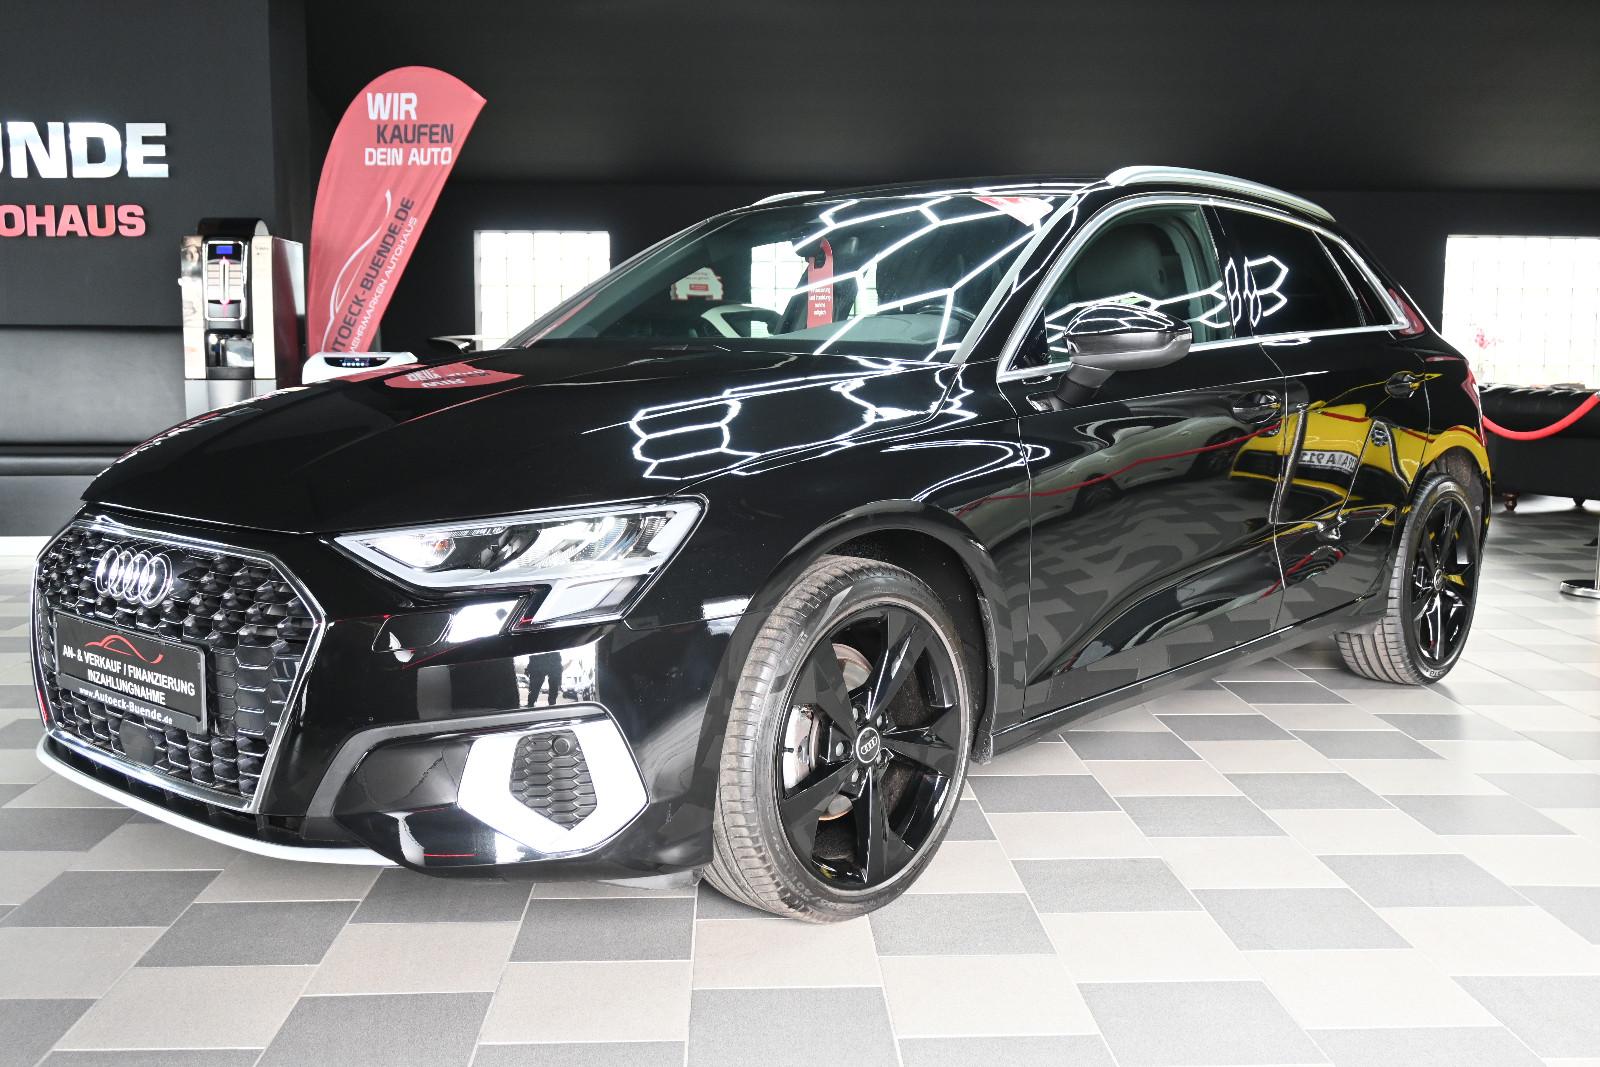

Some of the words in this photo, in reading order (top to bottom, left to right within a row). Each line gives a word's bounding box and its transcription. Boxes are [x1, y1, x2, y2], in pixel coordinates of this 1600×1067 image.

[366, 92, 418, 120] WIR
[0, 121, 169, 178] NDE
[376, 123, 454, 144] KAUFEN
[364, 147, 403, 166] DEIN
[407, 147, 452, 166] AUTO
[385, 217, 418, 278] AUTOHAUS
[63, 645, 76, 659] AN-
[77, 649, 83, 662] &
[84, 651, 122, 674] VERKAUF
[128, 665, 195, 696] FINANZIERUNG
[88, 669, 166, 705] INZAHLUNGNAHME
[79, 687, 173, 725] www.Autoeck-Buende.de
